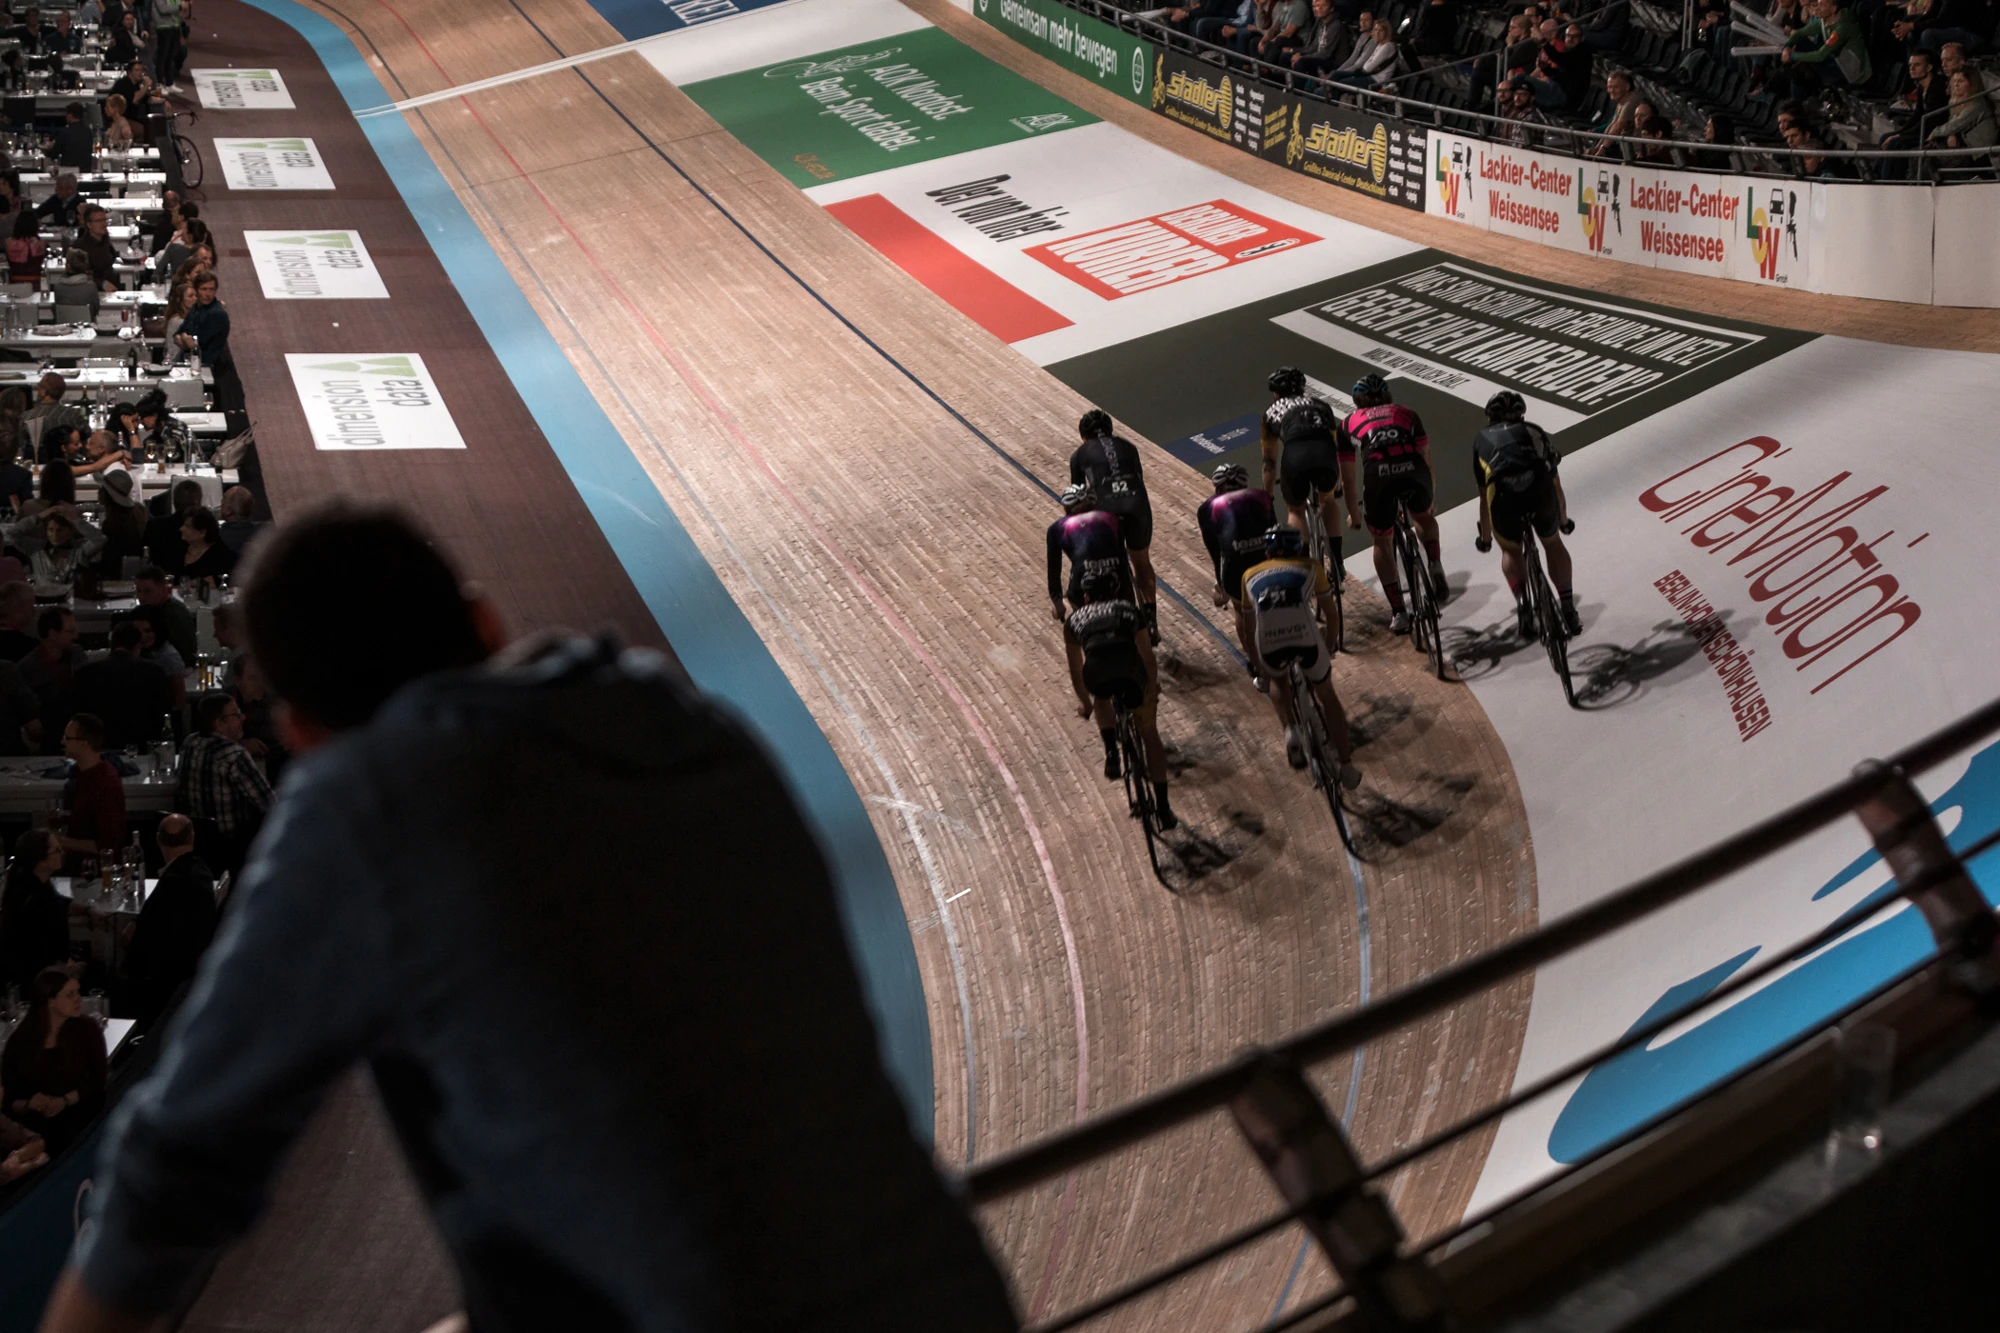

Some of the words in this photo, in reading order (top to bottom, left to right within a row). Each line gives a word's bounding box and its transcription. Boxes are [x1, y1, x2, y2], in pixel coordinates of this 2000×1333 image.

[1000, 0, 1047, 40] Gemeinsam
[1050, 17, 1073, 52] mehr
[1074, 23, 1117, 78] bewegen
[244, 80, 279, 92] data
[800, 76, 857, 103] Beim
[863, 63, 929, 88] AOK
[1166, 70, 1225, 116] stadler
[818, 97, 893, 127] Sport
[890, 80, 975, 121] Nordost.
[858, 120, 936, 152] dabei.
[1305, 121, 1377, 169] stadler
[230, 152, 279, 187] dimension
[276, 152, 316, 167] data
[1480, 150, 1572, 197] Lackier-Center
[924, 173, 1012, 207] Der
[1630, 178, 1739, 221] Lackier-Center
[951, 195, 1032, 225] von
[975, 206, 1070, 243] hier
[1158, 204, 1268, 246] BERLINER
[1489, 189, 1559, 234] Weissensee
[317, 249, 364, 269] data
[1046, 220, 1230, 294] KURIER
[1641, 221, 1724, 263] Weissensee
[264, 250, 323, 296] dimension
[1397, 269, 1460, 292] WAS
[1428, 280, 1496, 303] SIND
[1461, 290, 1547, 319] SCHON
[1320, 288, 1439, 332] GEGEN
[1385, 312, 1504, 355] EINEN
[1449, 331, 1664, 406] KAMERADEN?
[1549, 311, 1662, 349] FREUNDE
[1623, 329, 1688, 356] IM
[1650, 336, 1733, 366] NETZ
[374, 379, 432, 407] data
[312, 380, 386, 446] dimension
[1111, 480, 1130, 494] 52
[1638, 435, 1930, 695] CineMotion
[1653, 569, 1773, 743] BERLIN-HOHENSCHÖNHAUSEN
